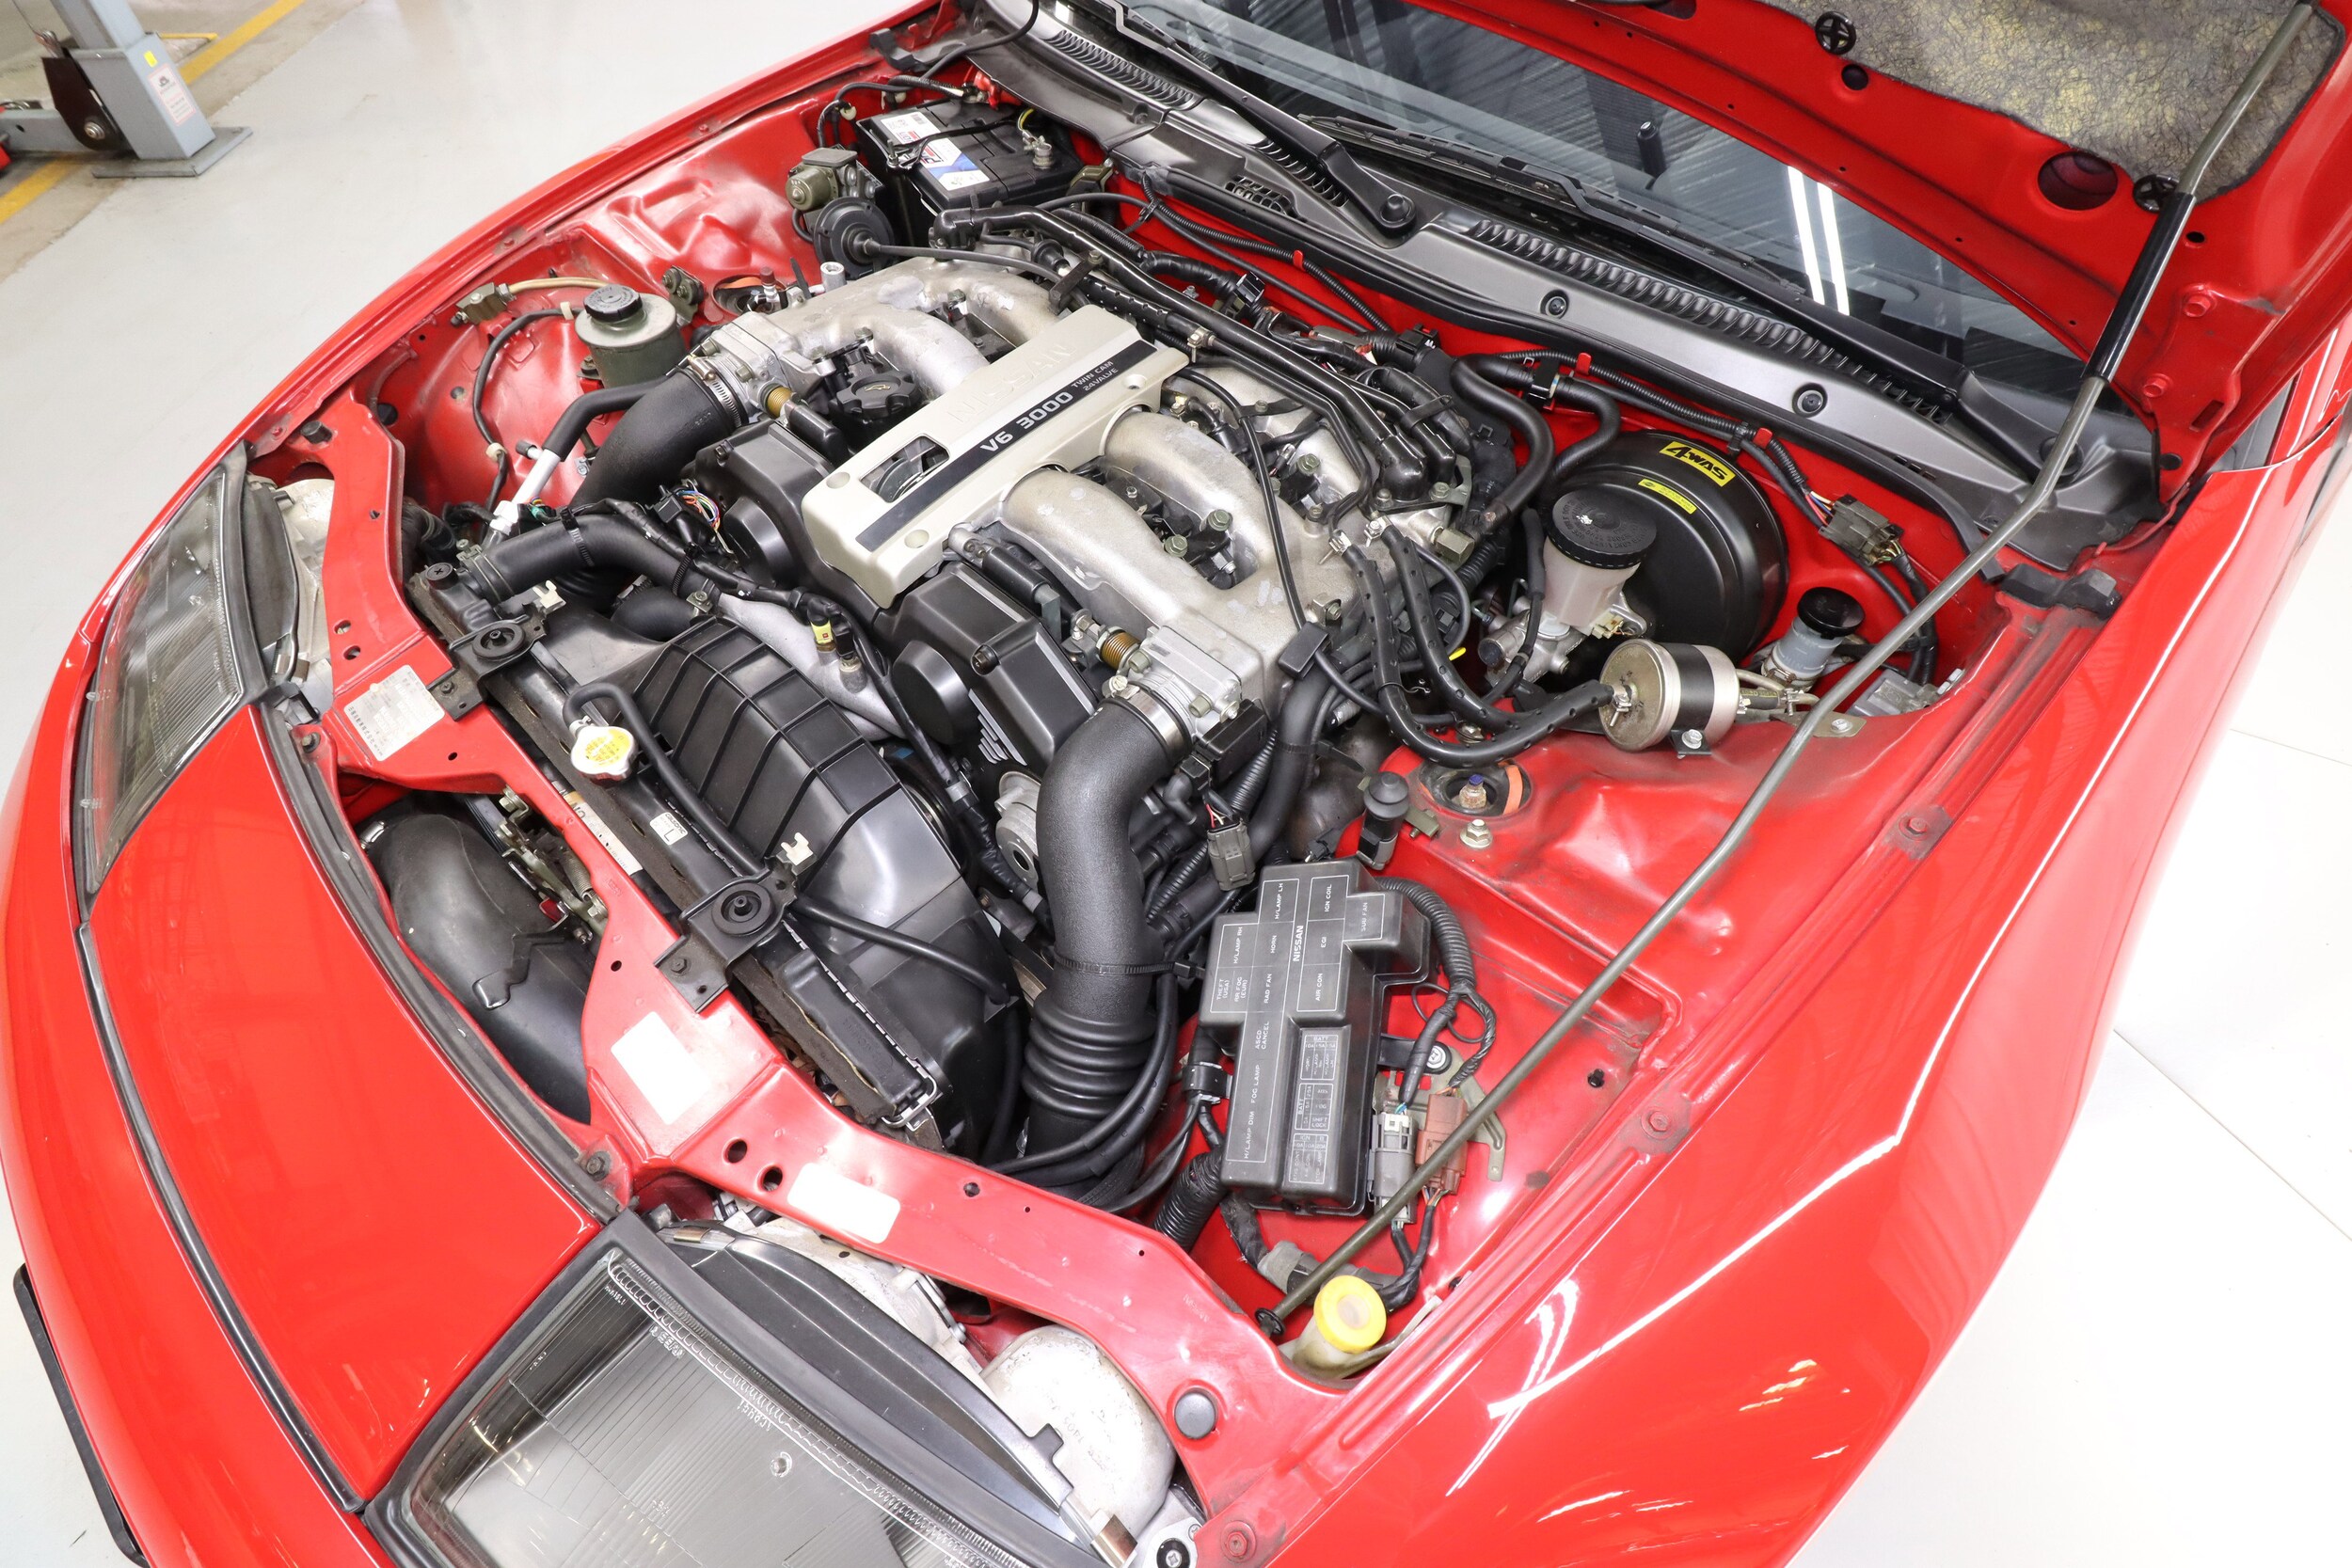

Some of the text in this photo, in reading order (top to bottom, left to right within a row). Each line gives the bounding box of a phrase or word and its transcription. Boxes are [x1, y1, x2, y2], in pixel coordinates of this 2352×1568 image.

[947, 344, 1076, 423] NISSAN
[1071, 360, 1114, 388] TWIN CAM
[1082, 368, 1119, 391] 24VALVE
[979, 390, 1073, 452] V6 3000
[1666, 446, 1728, 481] 4WAS
[663, 829, 674, 842] L
[1278, 882, 1283, 893] LH
[1233, 927, 1244, 964] H/LAMP RH
[1293, 925, 1304, 962] NISSAN
[1234, 991, 1240, 1003] RR
[1262, 1021, 1270, 1050] CANCEL
[1244, 1128, 1252, 1160] H/LAMP
